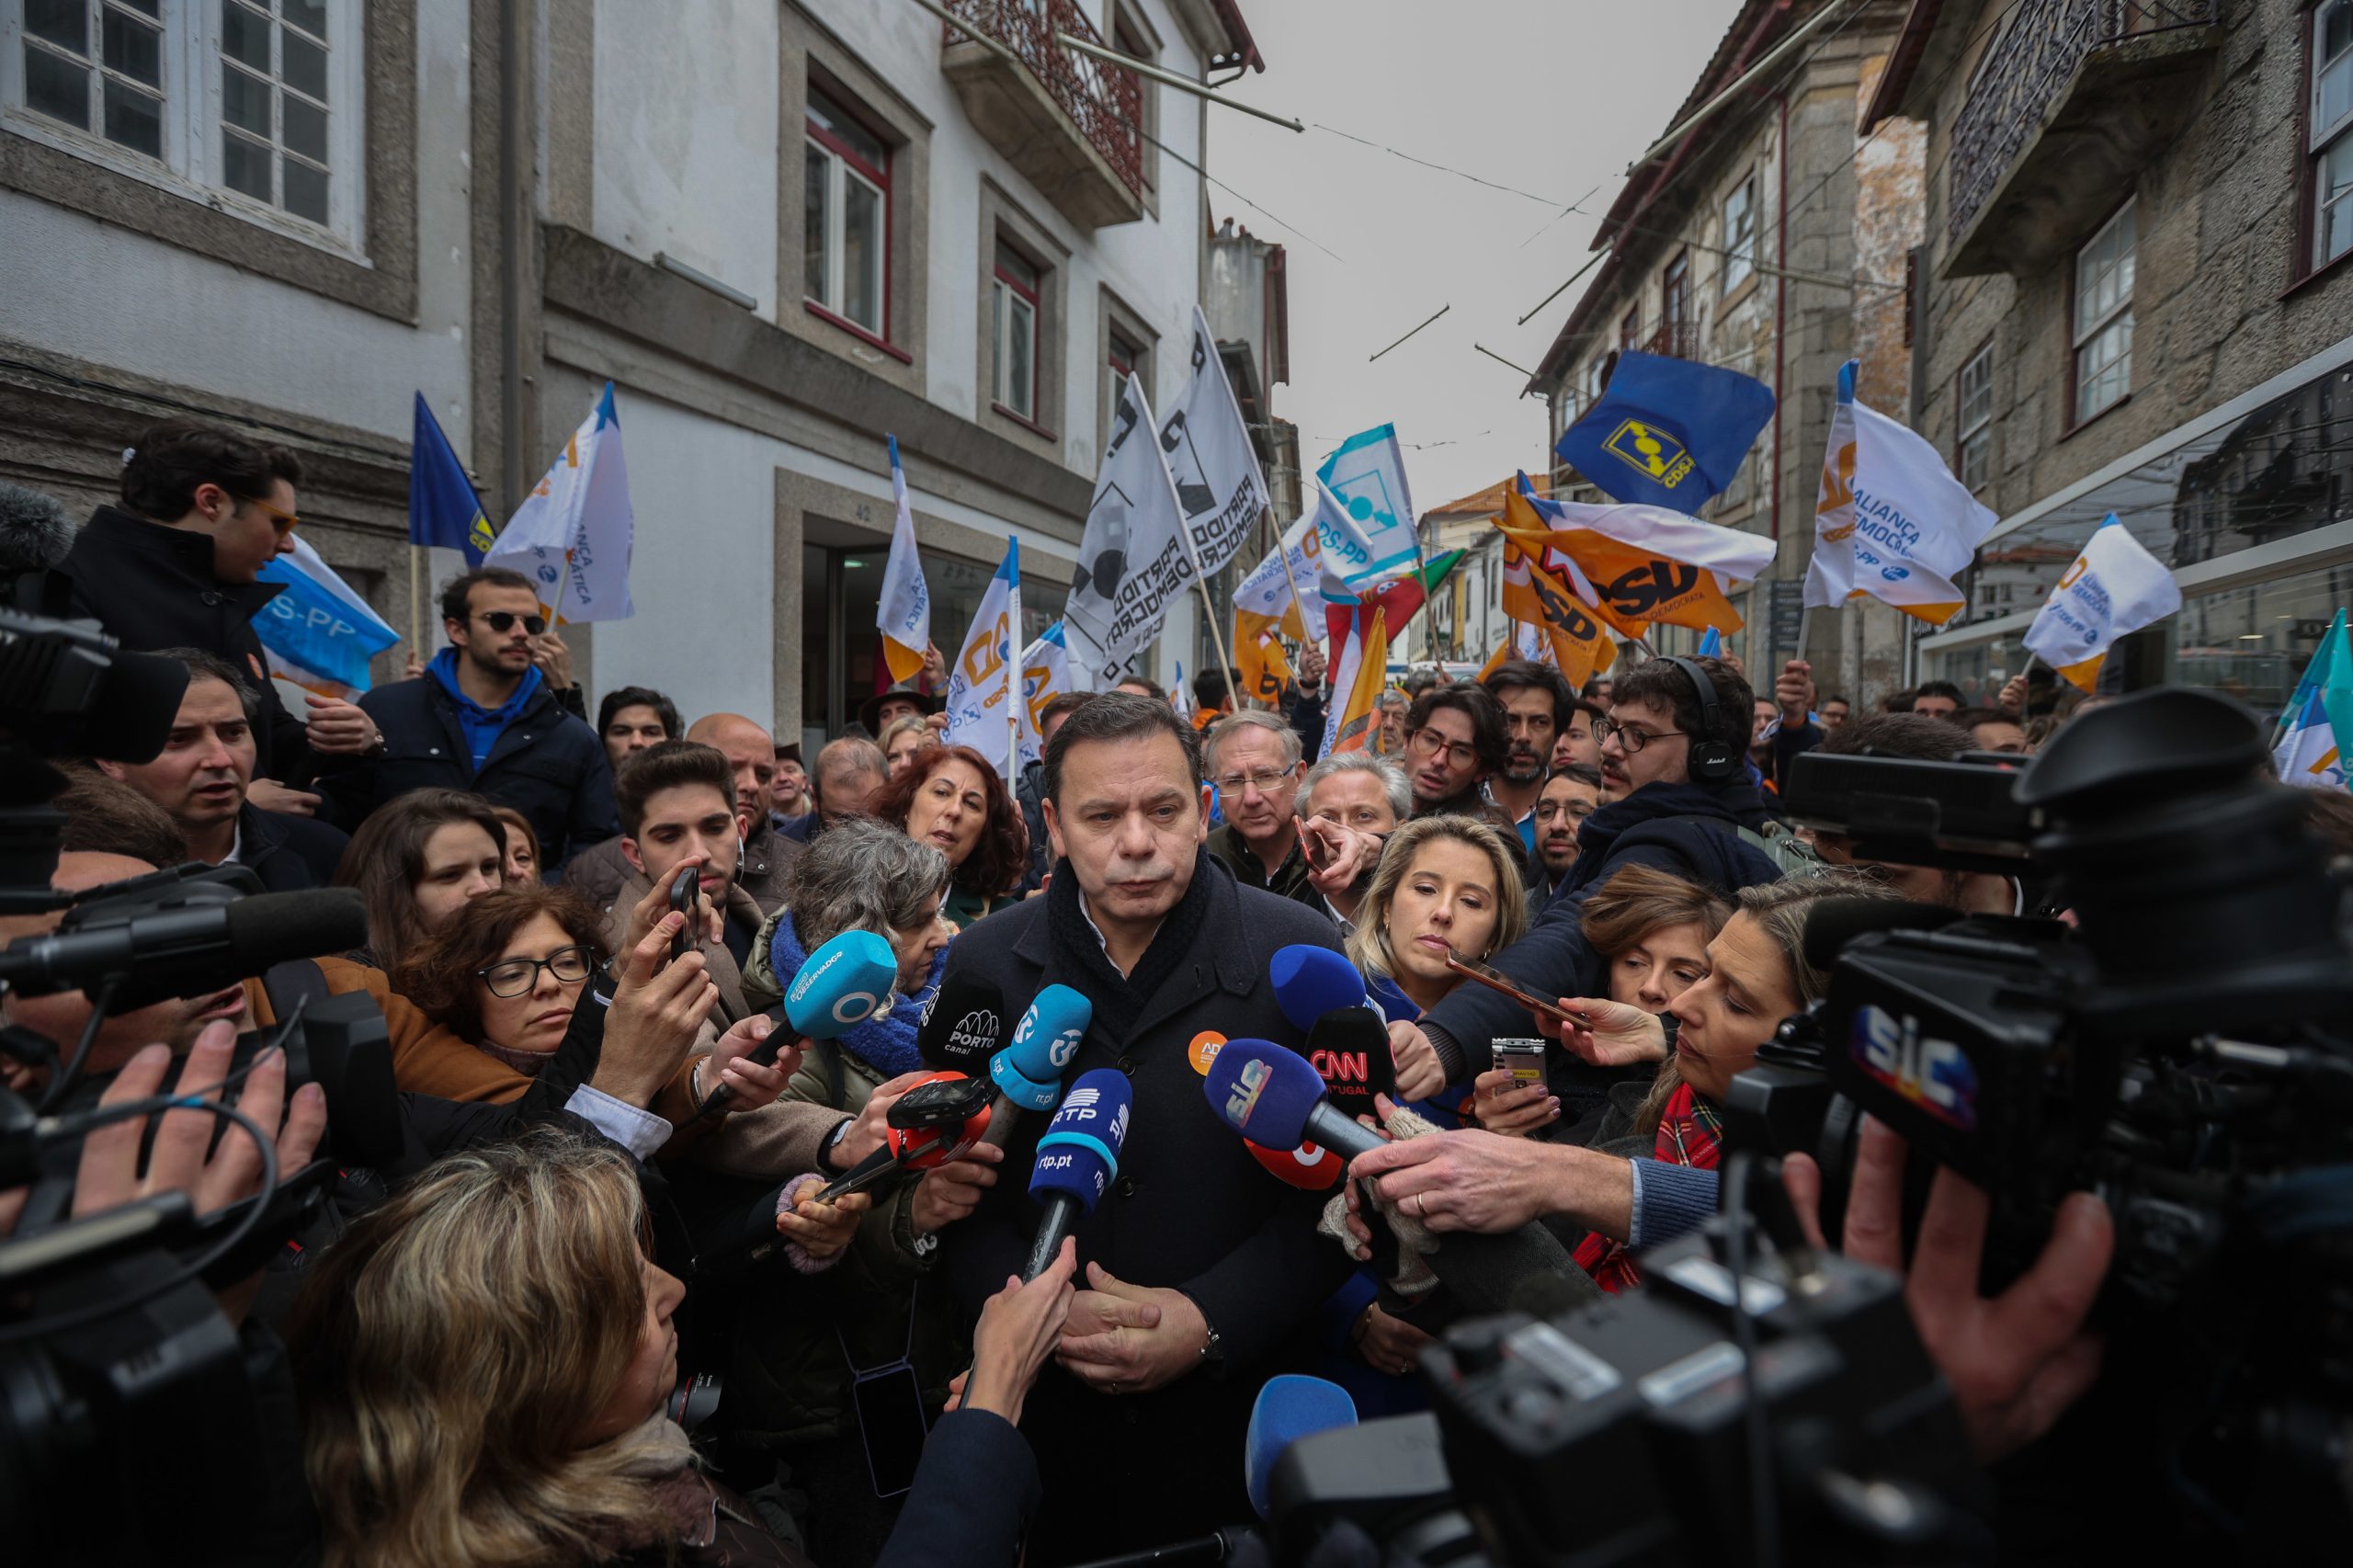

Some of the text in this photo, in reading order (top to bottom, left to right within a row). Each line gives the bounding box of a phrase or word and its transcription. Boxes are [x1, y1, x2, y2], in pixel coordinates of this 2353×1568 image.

[1853, 489, 1920, 546] ALIANÇA
[1318, 520, 1368, 564] DS-PP
[262, 594, 357, 637] S-PP
[944, 1044, 971, 1055] canal
[949, 1030, 995, 1049] PORTO
[1309, 1049, 1368, 1082] CNN
[1051, 1108, 1097, 1127] RTP
[1039, 1154, 1073, 1169] rtp.pt
